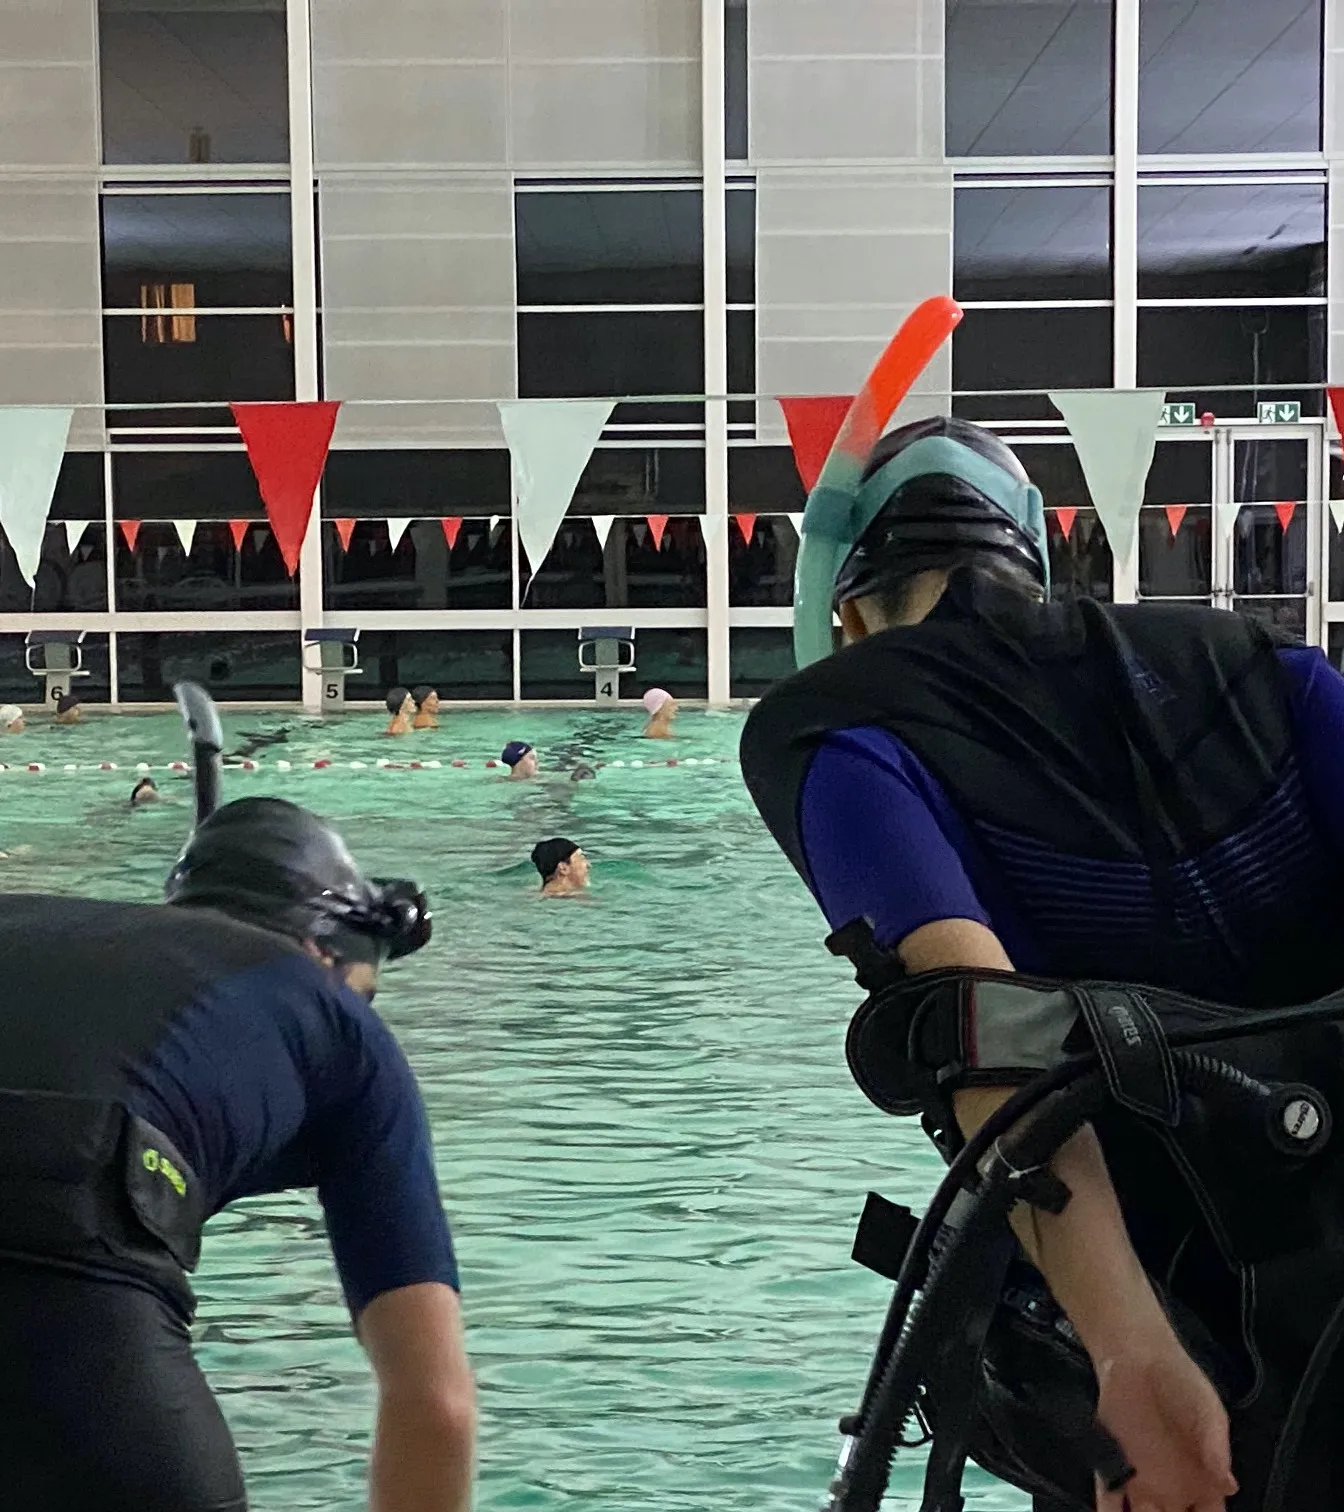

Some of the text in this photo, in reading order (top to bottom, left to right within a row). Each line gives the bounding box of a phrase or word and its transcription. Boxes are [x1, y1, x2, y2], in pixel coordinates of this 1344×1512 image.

[51, 686, 64, 701] 6
[326, 684, 339, 699] 5
[601, 682, 613, 697] 4
